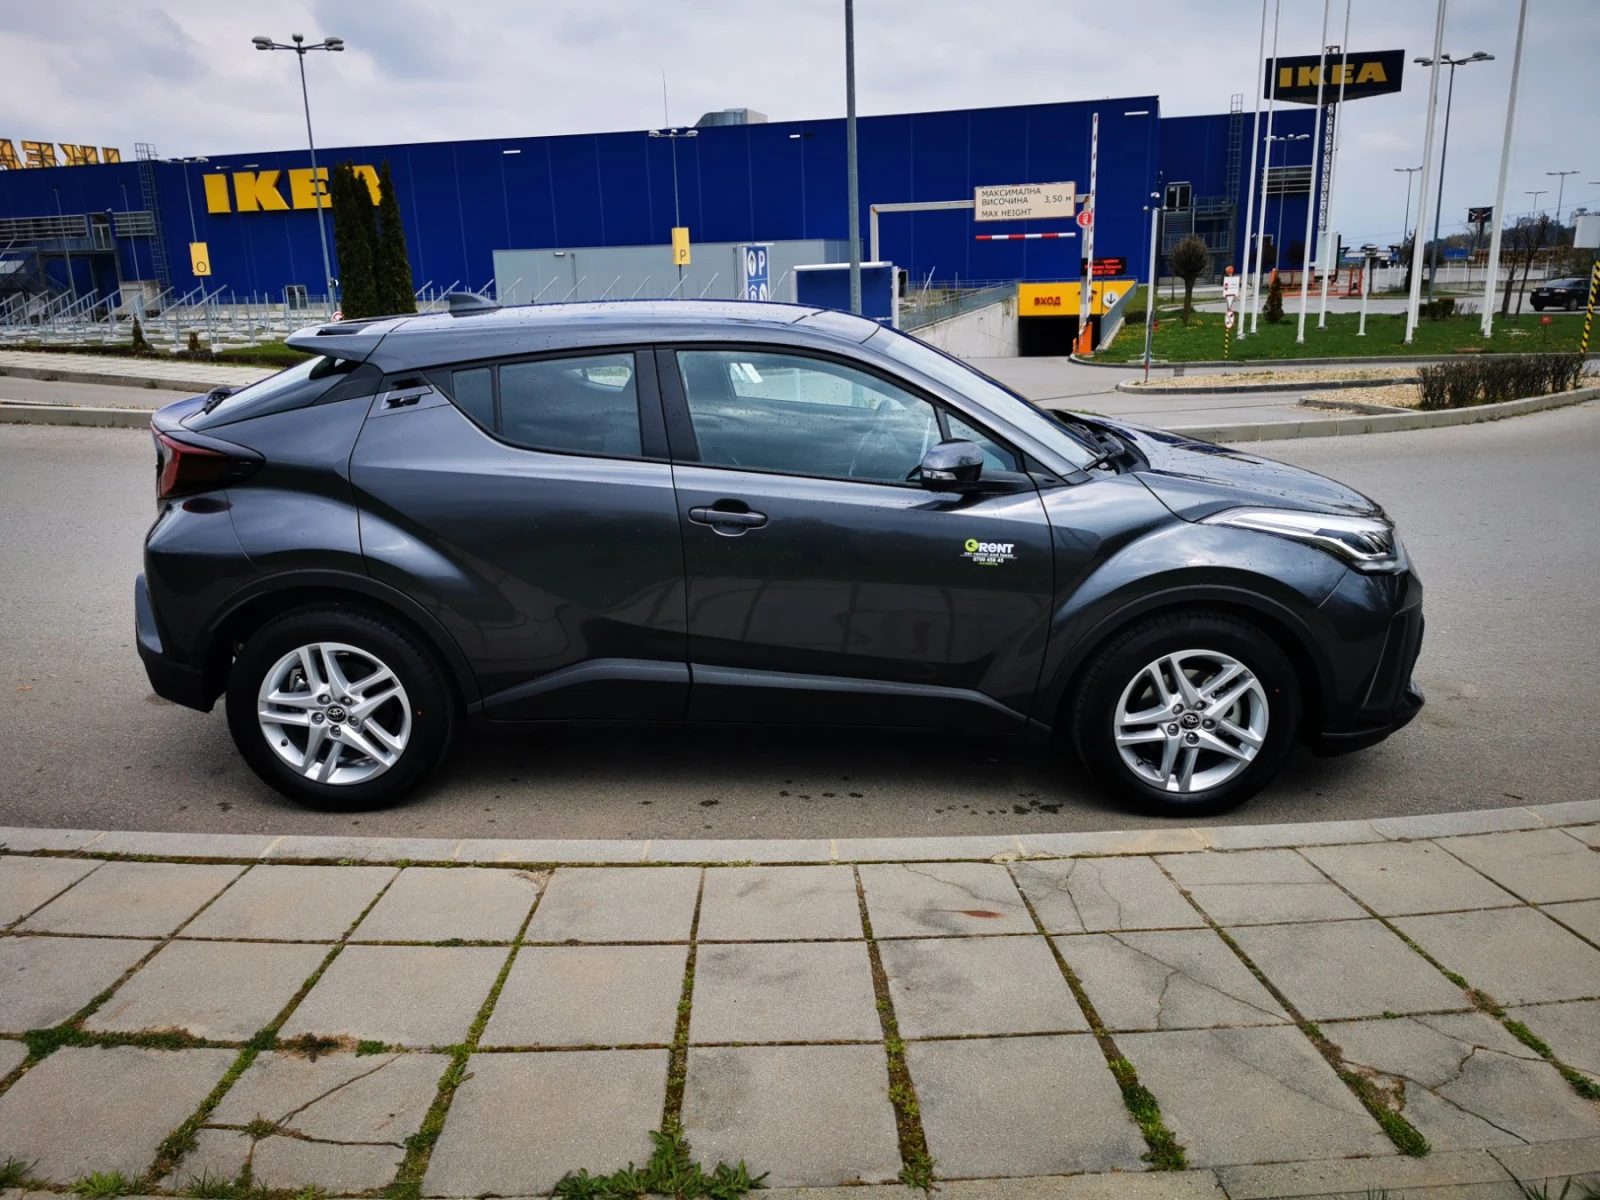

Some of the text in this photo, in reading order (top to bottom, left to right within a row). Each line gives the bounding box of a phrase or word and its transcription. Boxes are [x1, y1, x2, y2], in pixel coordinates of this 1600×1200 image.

[1279, 62, 1388, 88] IKEA
[981, 187, 1042, 197] МАКСИМАЛНА
[981, 197, 1029, 206] ВИСОЧИНА
[1001, 208, 1032, 216] HEIGHT
[680, 249, 687, 262] P
[758, 250, 766, 275] P
[1034, 296, 1061, 306] ВХОД
